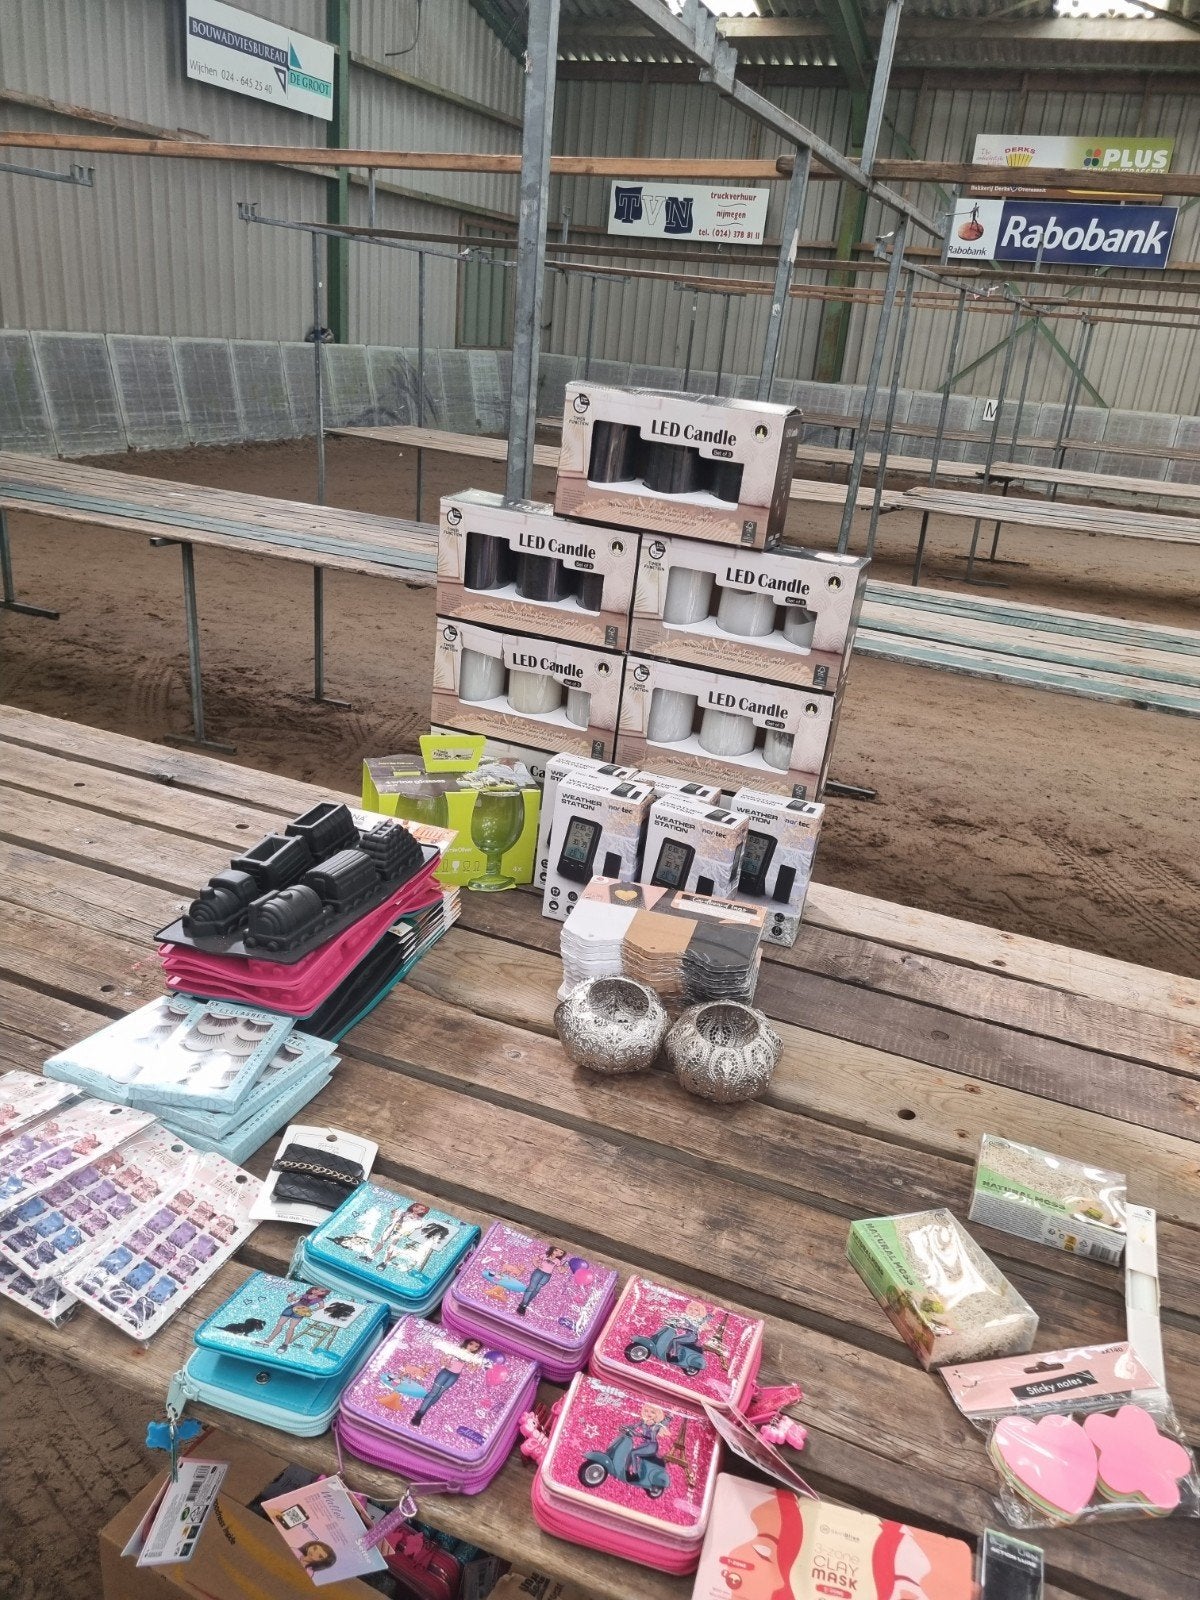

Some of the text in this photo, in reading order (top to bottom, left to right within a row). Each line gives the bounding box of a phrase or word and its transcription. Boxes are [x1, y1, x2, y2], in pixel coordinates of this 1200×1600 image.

[191, 20, 286, 64] BOUWADVIESBUREAU
[189, 59, 218, 77] Wijchen
[221, 69, 234, 82] 024
[240, 75, 253, 88] 645
[254, 81, 263, 92] 25
[264, 83, 273, 94] 40
[290, 73, 330, 95] DE GROOT
[1004, 146, 1036, 155] DERKS
[1102, 148, 1169, 168] PLUS
[710, 191, 757, 201] truckverhuur
[616, 189, 694, 230] TVN
[716, 210, 746, 220] nijmegen
[698, 228, 710, 236] tel.
[712, 228, 731, 237] (024)
[733, 230, 744, 238] 378
[1000, 215, 1169, 255] Rabobank
[948, 245, 987, 256] Rabobank
[651, 419, 737, 447] LED Candle
[519, 533, 596, 560] LED Candle
[726, 567, 810, 596] LED Candle
[512, 652, 584, 679] LED Candle
[708, 691, 789, 719] LED Candle
[561, 793, 602, 807] WEATHER
[561, 799, 595, 811] STATION
[655, 814, 696, 830] WEATHER
[736, 806, 779, 820] WEATHER
[748, 815, 771, 825] ATION
[654, 820, 689, 834] STATION
[219, 1008, 267, 1019] EYELASHES
[982, 1180, 1066, 1211] NATURAL MOSS
[503, 1226, 533, 1243] Selfie
[865, 1223, 915, 1286] NATURAL MOSS
[415, 1320, 447, 1338] Selfie
[1026, 1377, 1083, 1396] Sticky notes
[213, 1499, 226, 1528] oodness
[813, 1555, 860, 1577] CLAY
[811, 1568, 858, 1591] MASK
